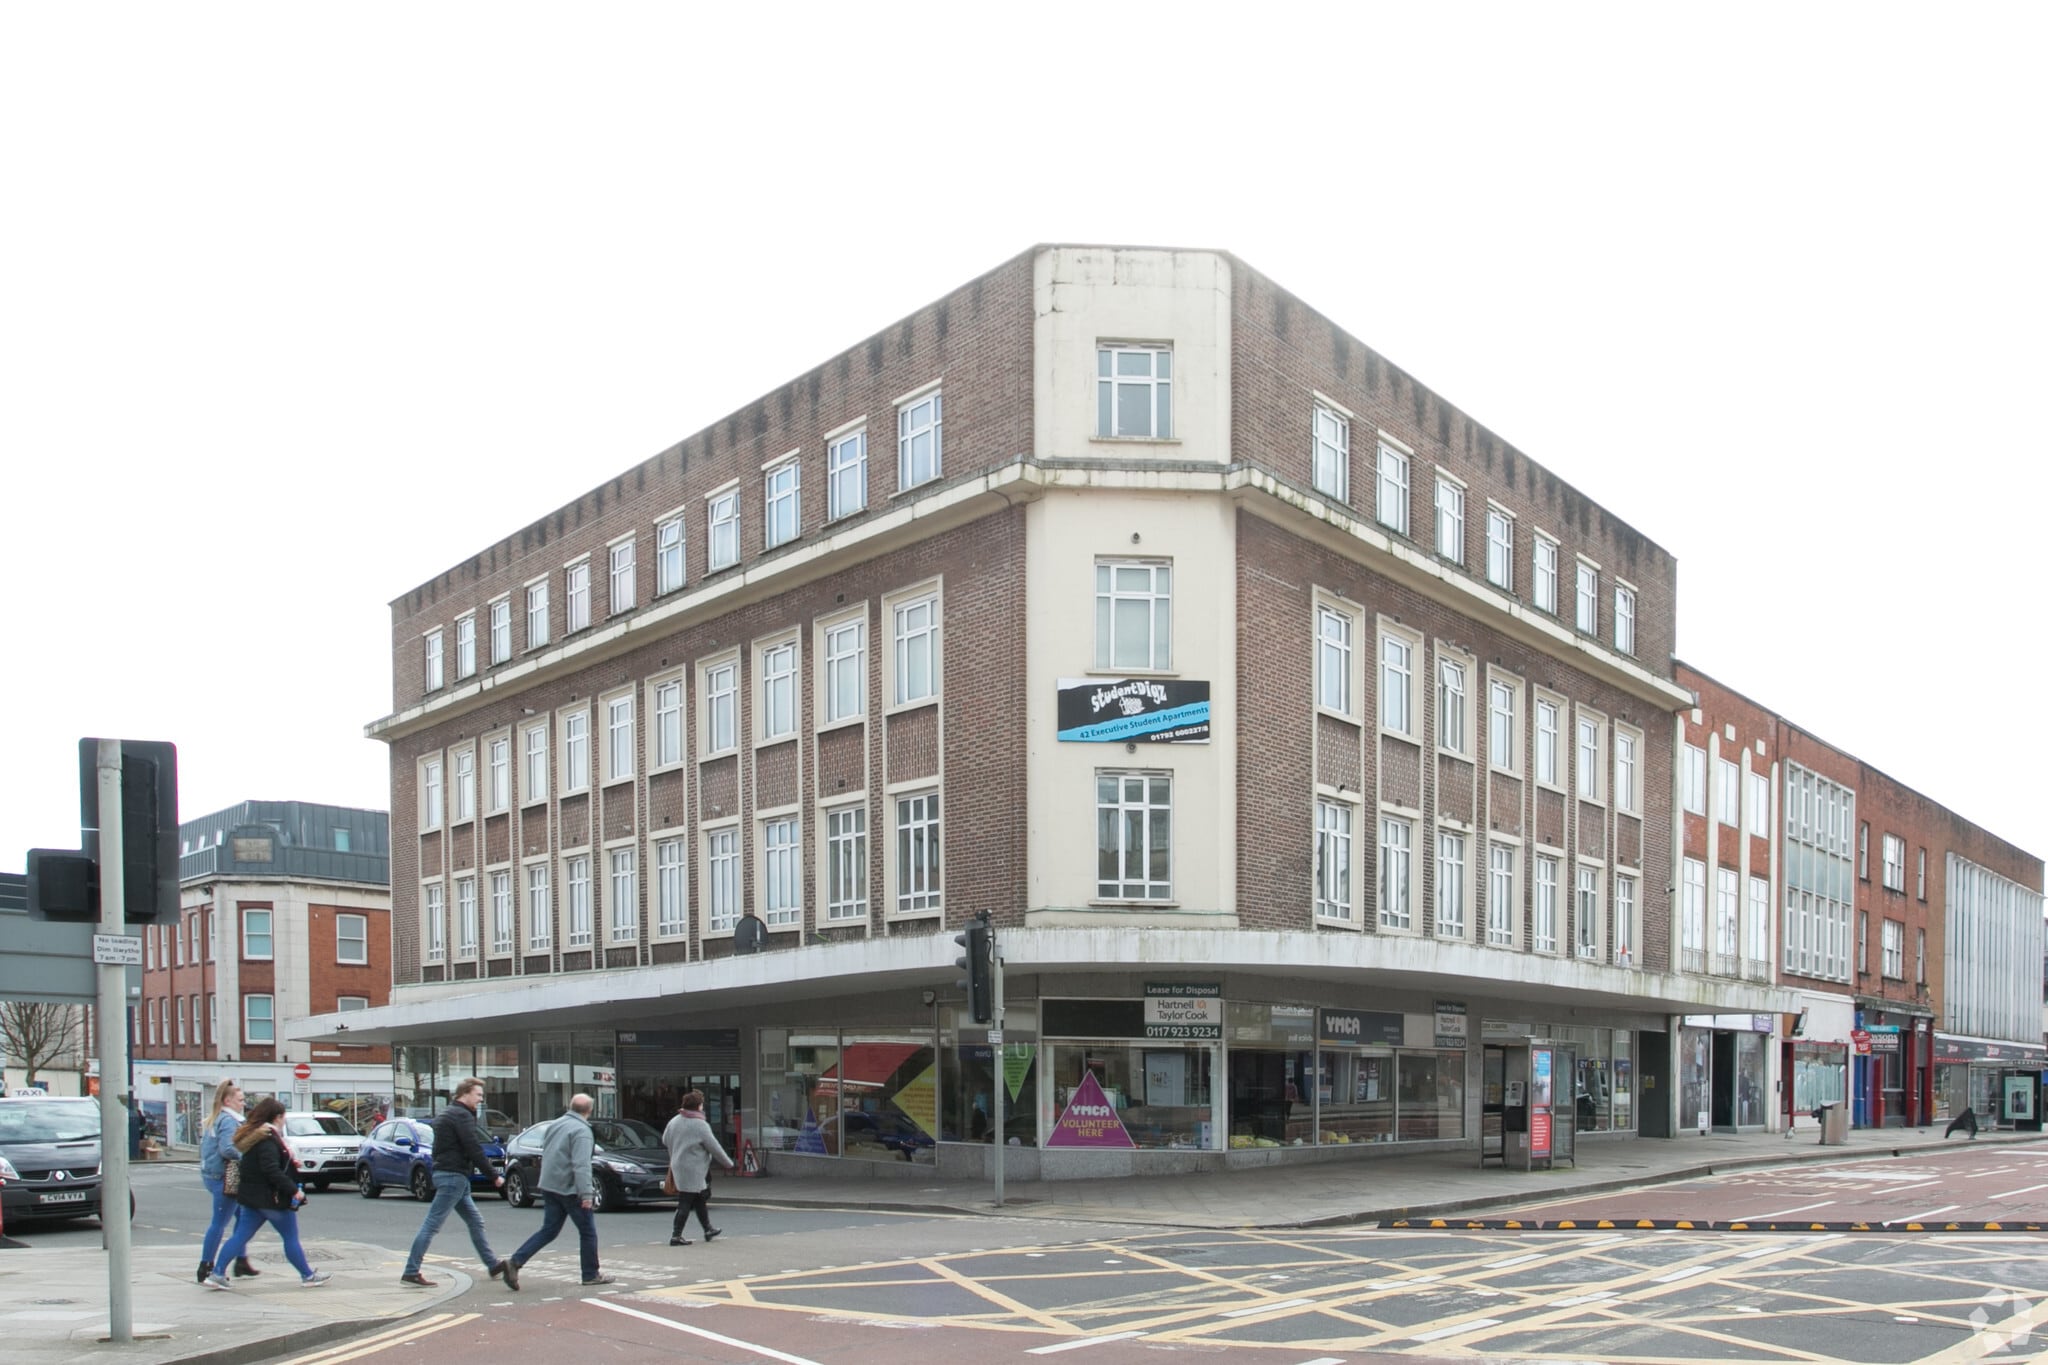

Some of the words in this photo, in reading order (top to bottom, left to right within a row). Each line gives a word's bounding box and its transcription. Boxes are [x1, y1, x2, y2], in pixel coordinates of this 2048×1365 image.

[1091, 681, 1168, 713] StudentDigz
[1079, 731, 1090, 739] 42
[1091, 724, 1129, 737] Executive
[1130, 715, 1161, 730] Student
[1162, 706, 1209, 723] Apartments
[1147, 986, 1170, 994] Lease
[1171, 986, 1184, 994] for
[1185, 986, 1219, 996] Disposal
[1157, 1000, 1194, 1009] Hartnell
[1157, 1010, 1184, 1021] Taylor
[1184, 1010, 1208, 1020] Cook
[1326, 1015, 1361, 1035] YMCA
[1146, 1026, 1170, 1037] 0117
[1170, 1026, 1190, 1037] 923
[1191, 1026, 1219, 1037] 9234
[15, 1089, 42, 1097] TAXI
[1071, 1104, 1110, 1117] YMCA
[1061, 1119, 1120, 1129] VOLUNTEER
[1078, 1128, 1104, 1137] HERE
